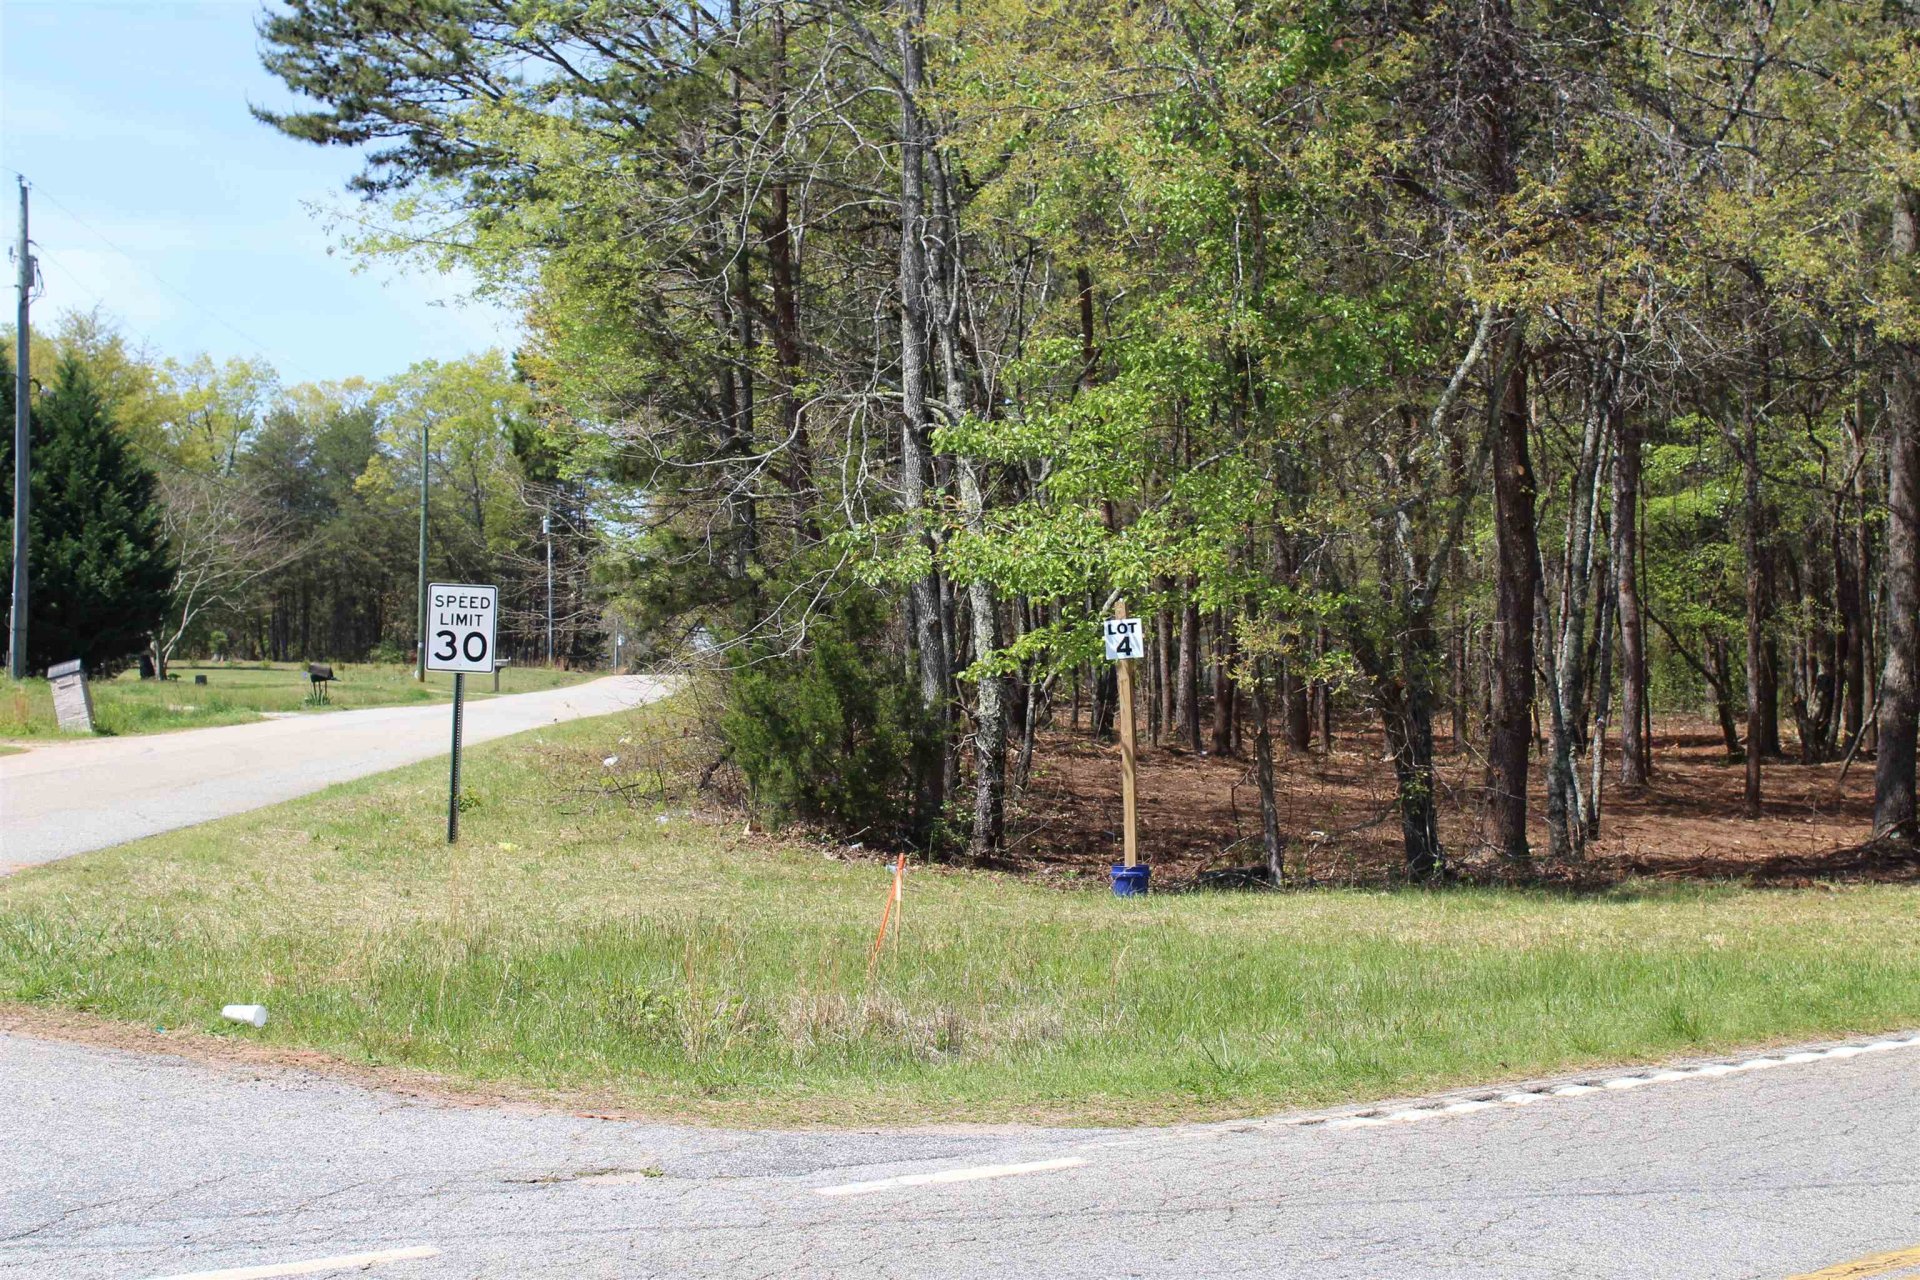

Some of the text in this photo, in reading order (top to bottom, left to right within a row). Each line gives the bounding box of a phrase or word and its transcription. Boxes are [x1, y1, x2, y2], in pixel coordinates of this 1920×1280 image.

[435, 595, 490, 609] SPEED
[440, 613, 483, 626] LIMIT
[1108, 622, 1137, 635] LOT
[434, 630, 487, 662] 30
[1117, 636, 1132, 656] 4
